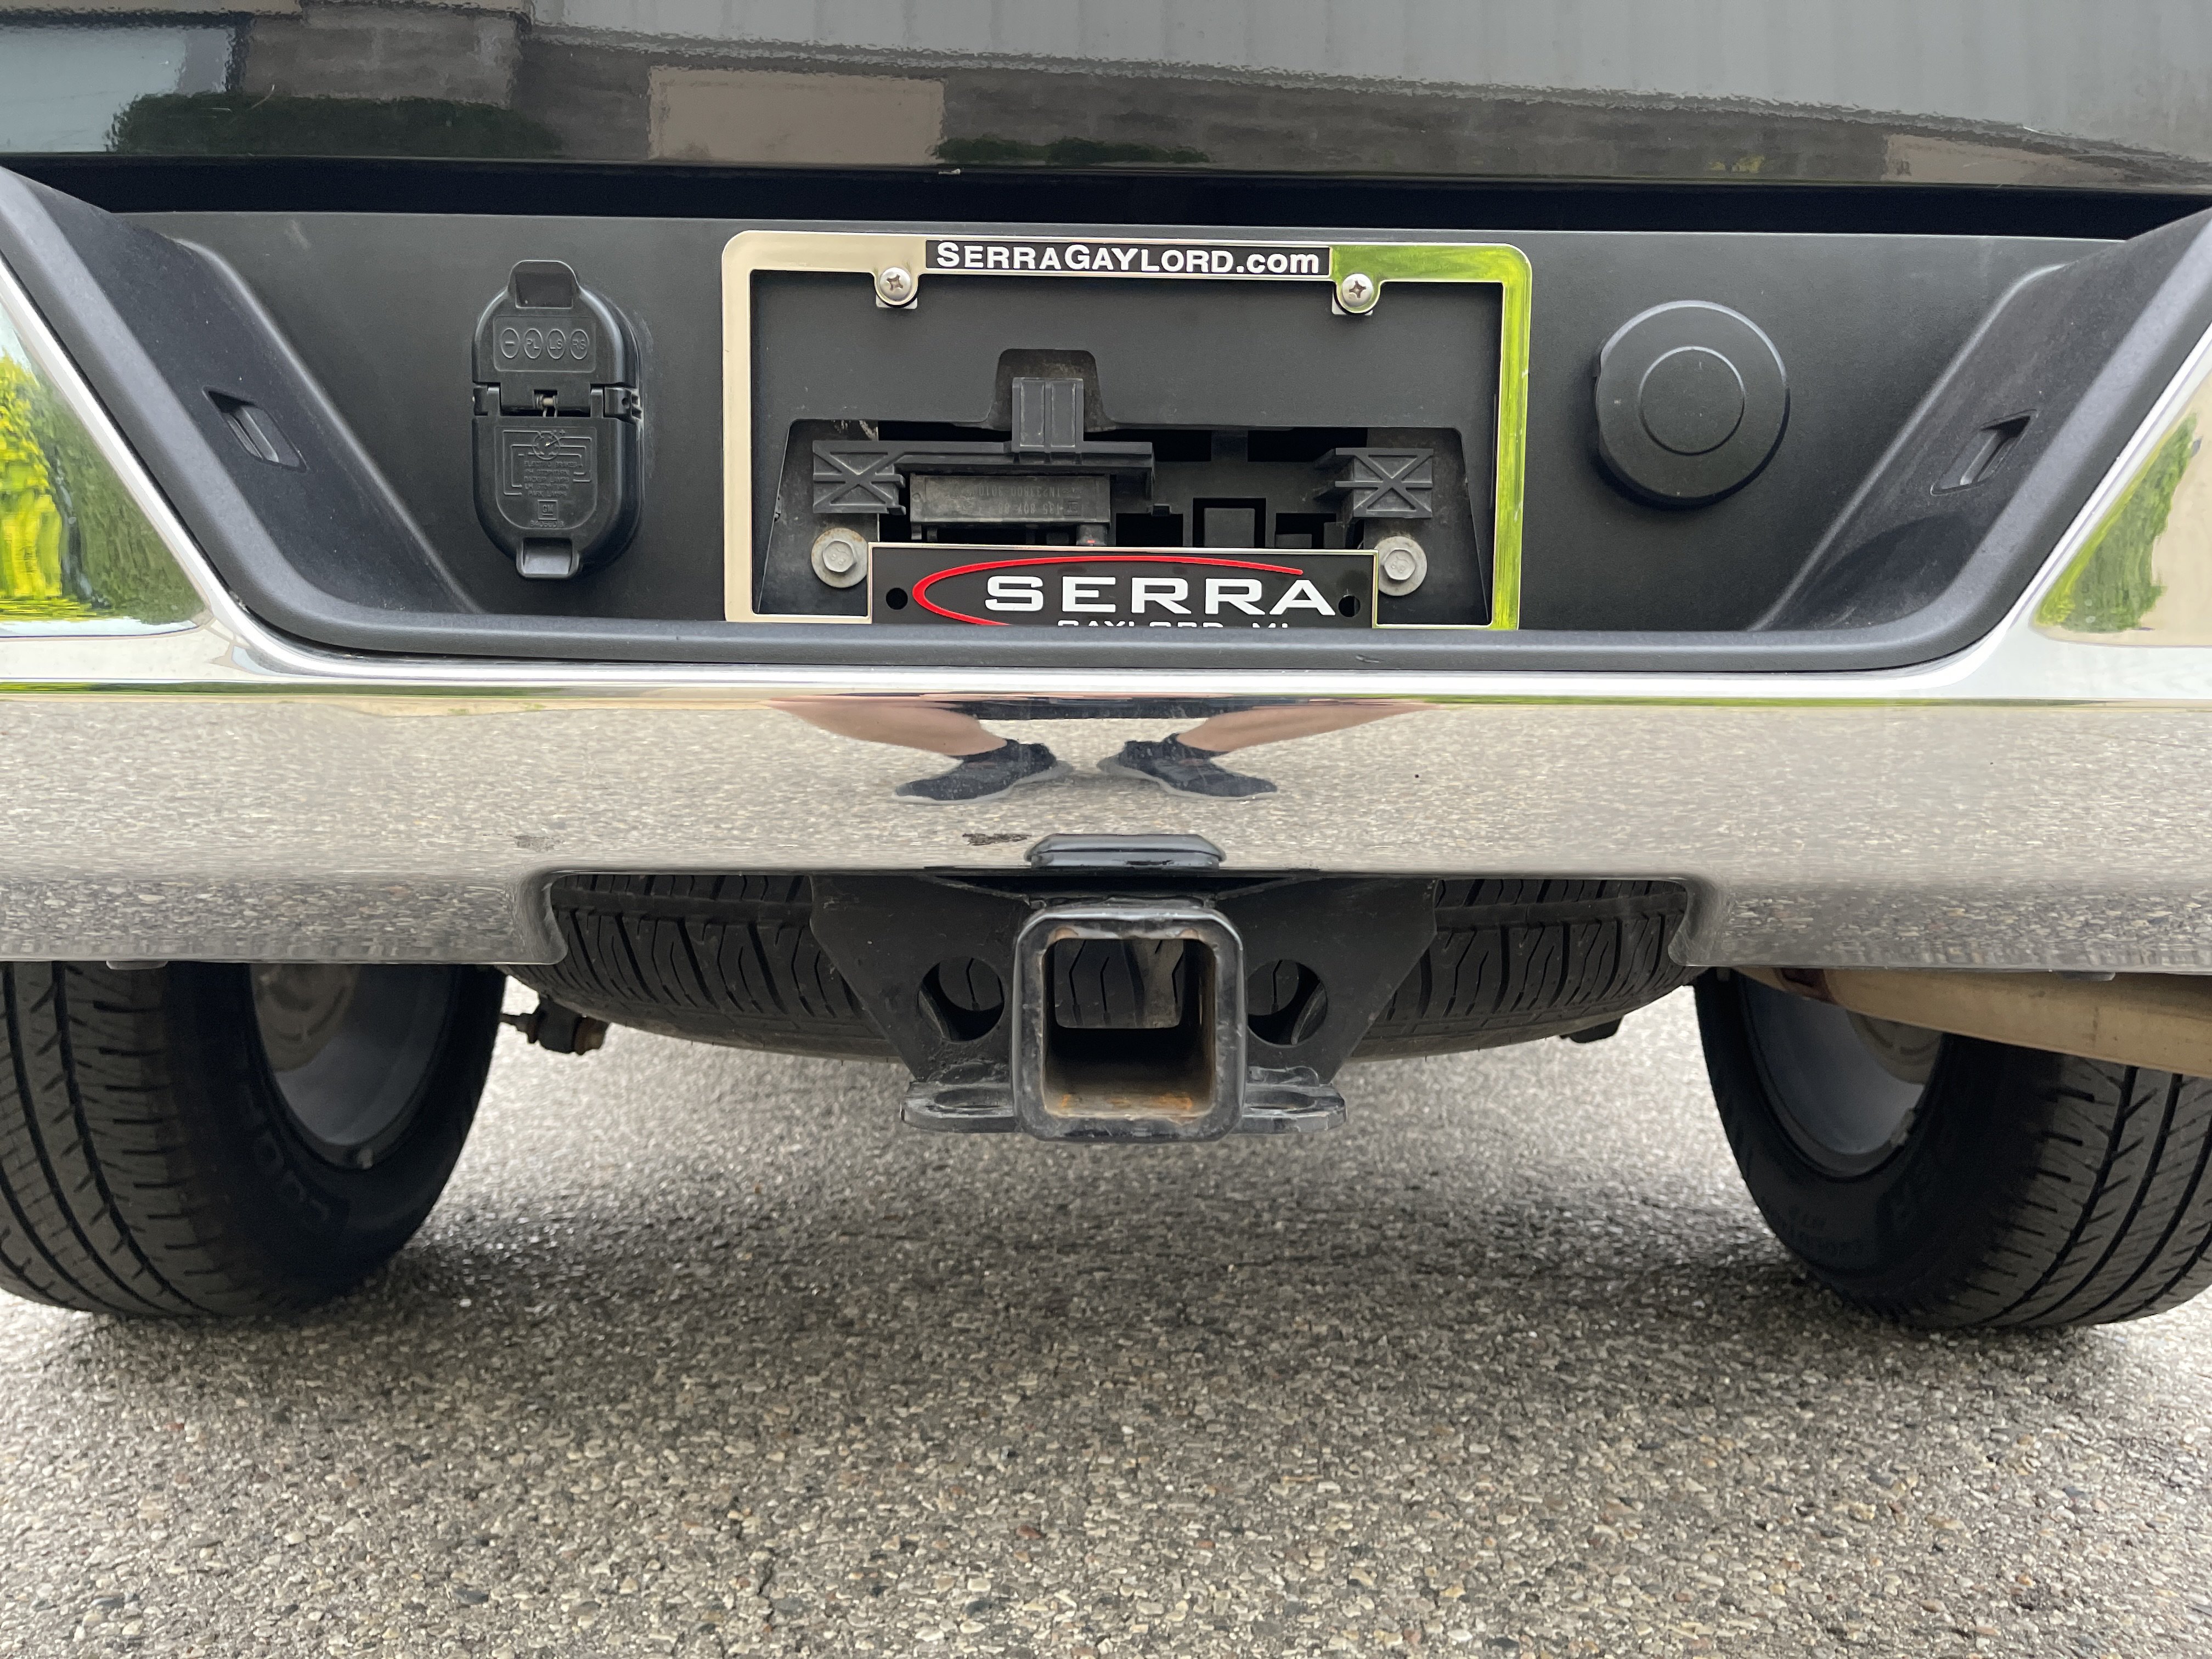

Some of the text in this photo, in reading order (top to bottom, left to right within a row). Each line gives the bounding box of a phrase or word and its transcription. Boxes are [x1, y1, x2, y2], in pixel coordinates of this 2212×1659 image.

[936, 241, 1318, 274] SERRAGAYLORD.com
[549, 338, 563, 350] LS
[984, 575, 1335, 616] SERRA
